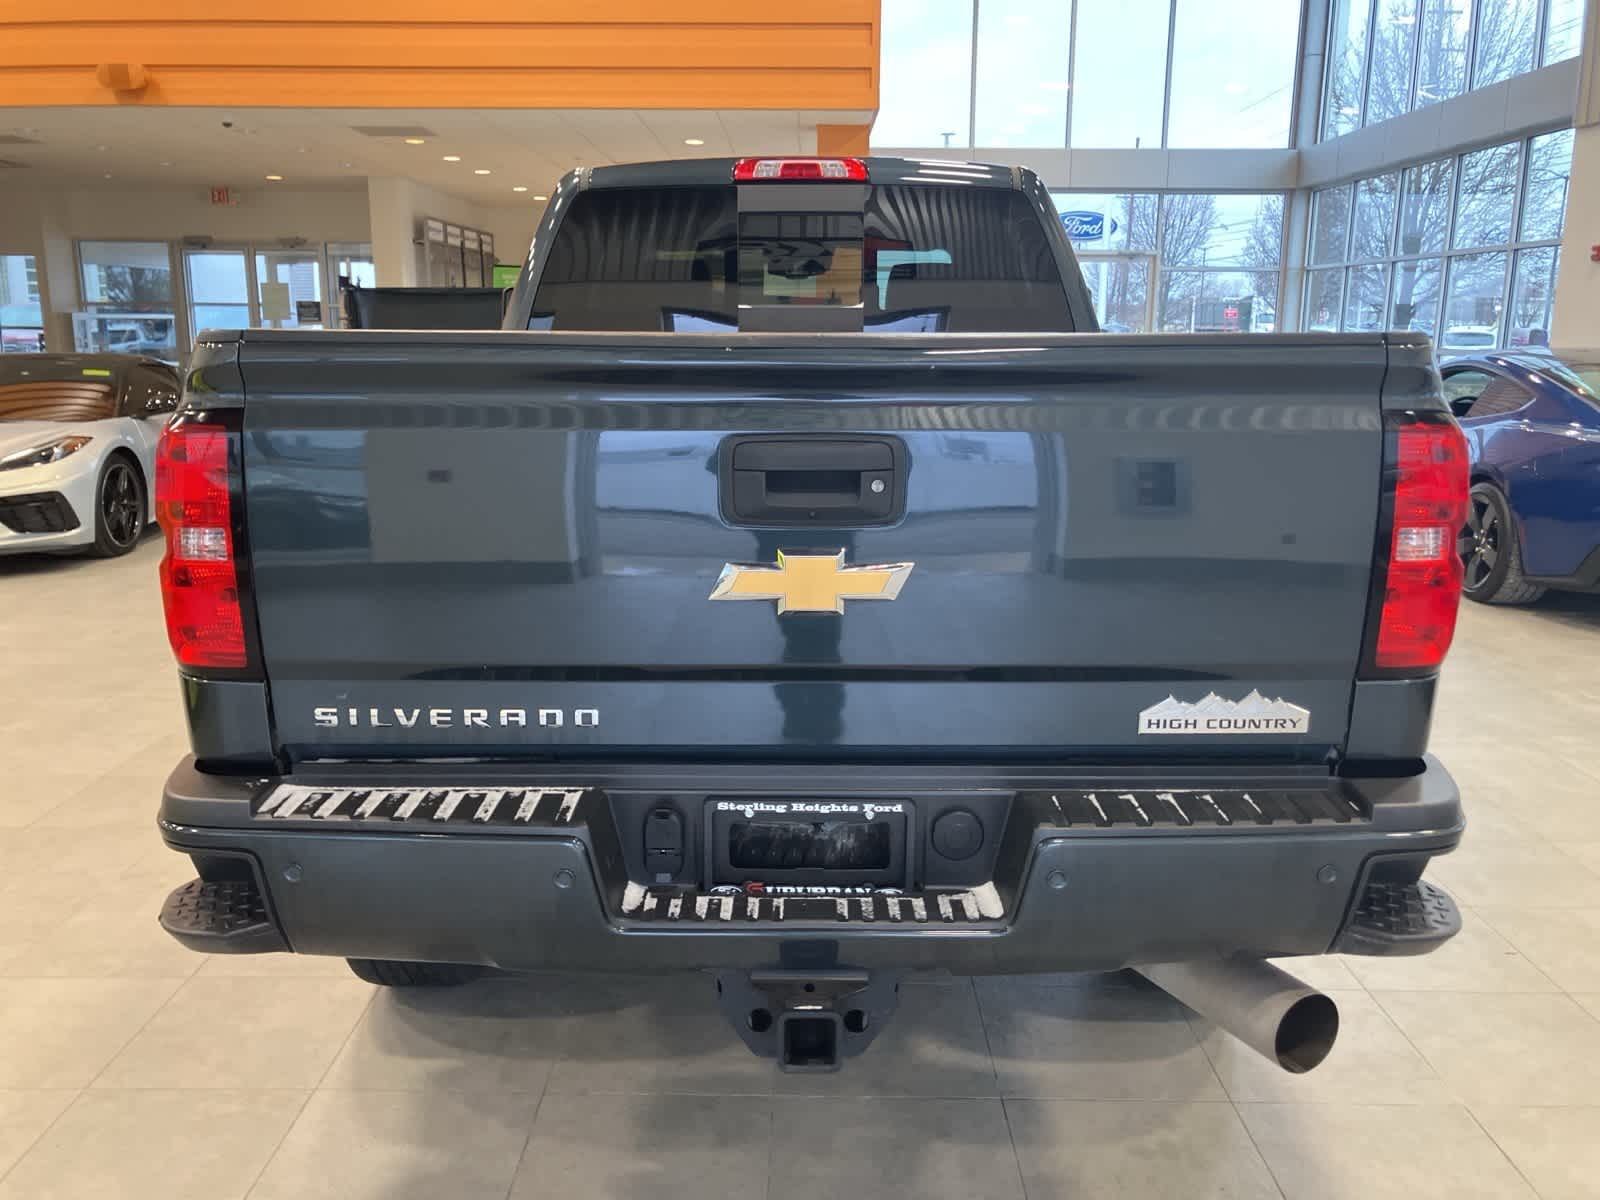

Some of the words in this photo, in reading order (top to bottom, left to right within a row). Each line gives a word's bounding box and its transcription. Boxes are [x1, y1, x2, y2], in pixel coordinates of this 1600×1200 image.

[1064, 216, 1103, 235] Ford
[314, 708, 600, 728] SILVERADO
[1147, 718, 1198, 729] HIGH
[1206, 718, 1302, 729] COUNTRY
[717, 802, 788, 814] Sterling
[791, 803, 859, 814] Heights
[863, 803, 903, 814] Ford
